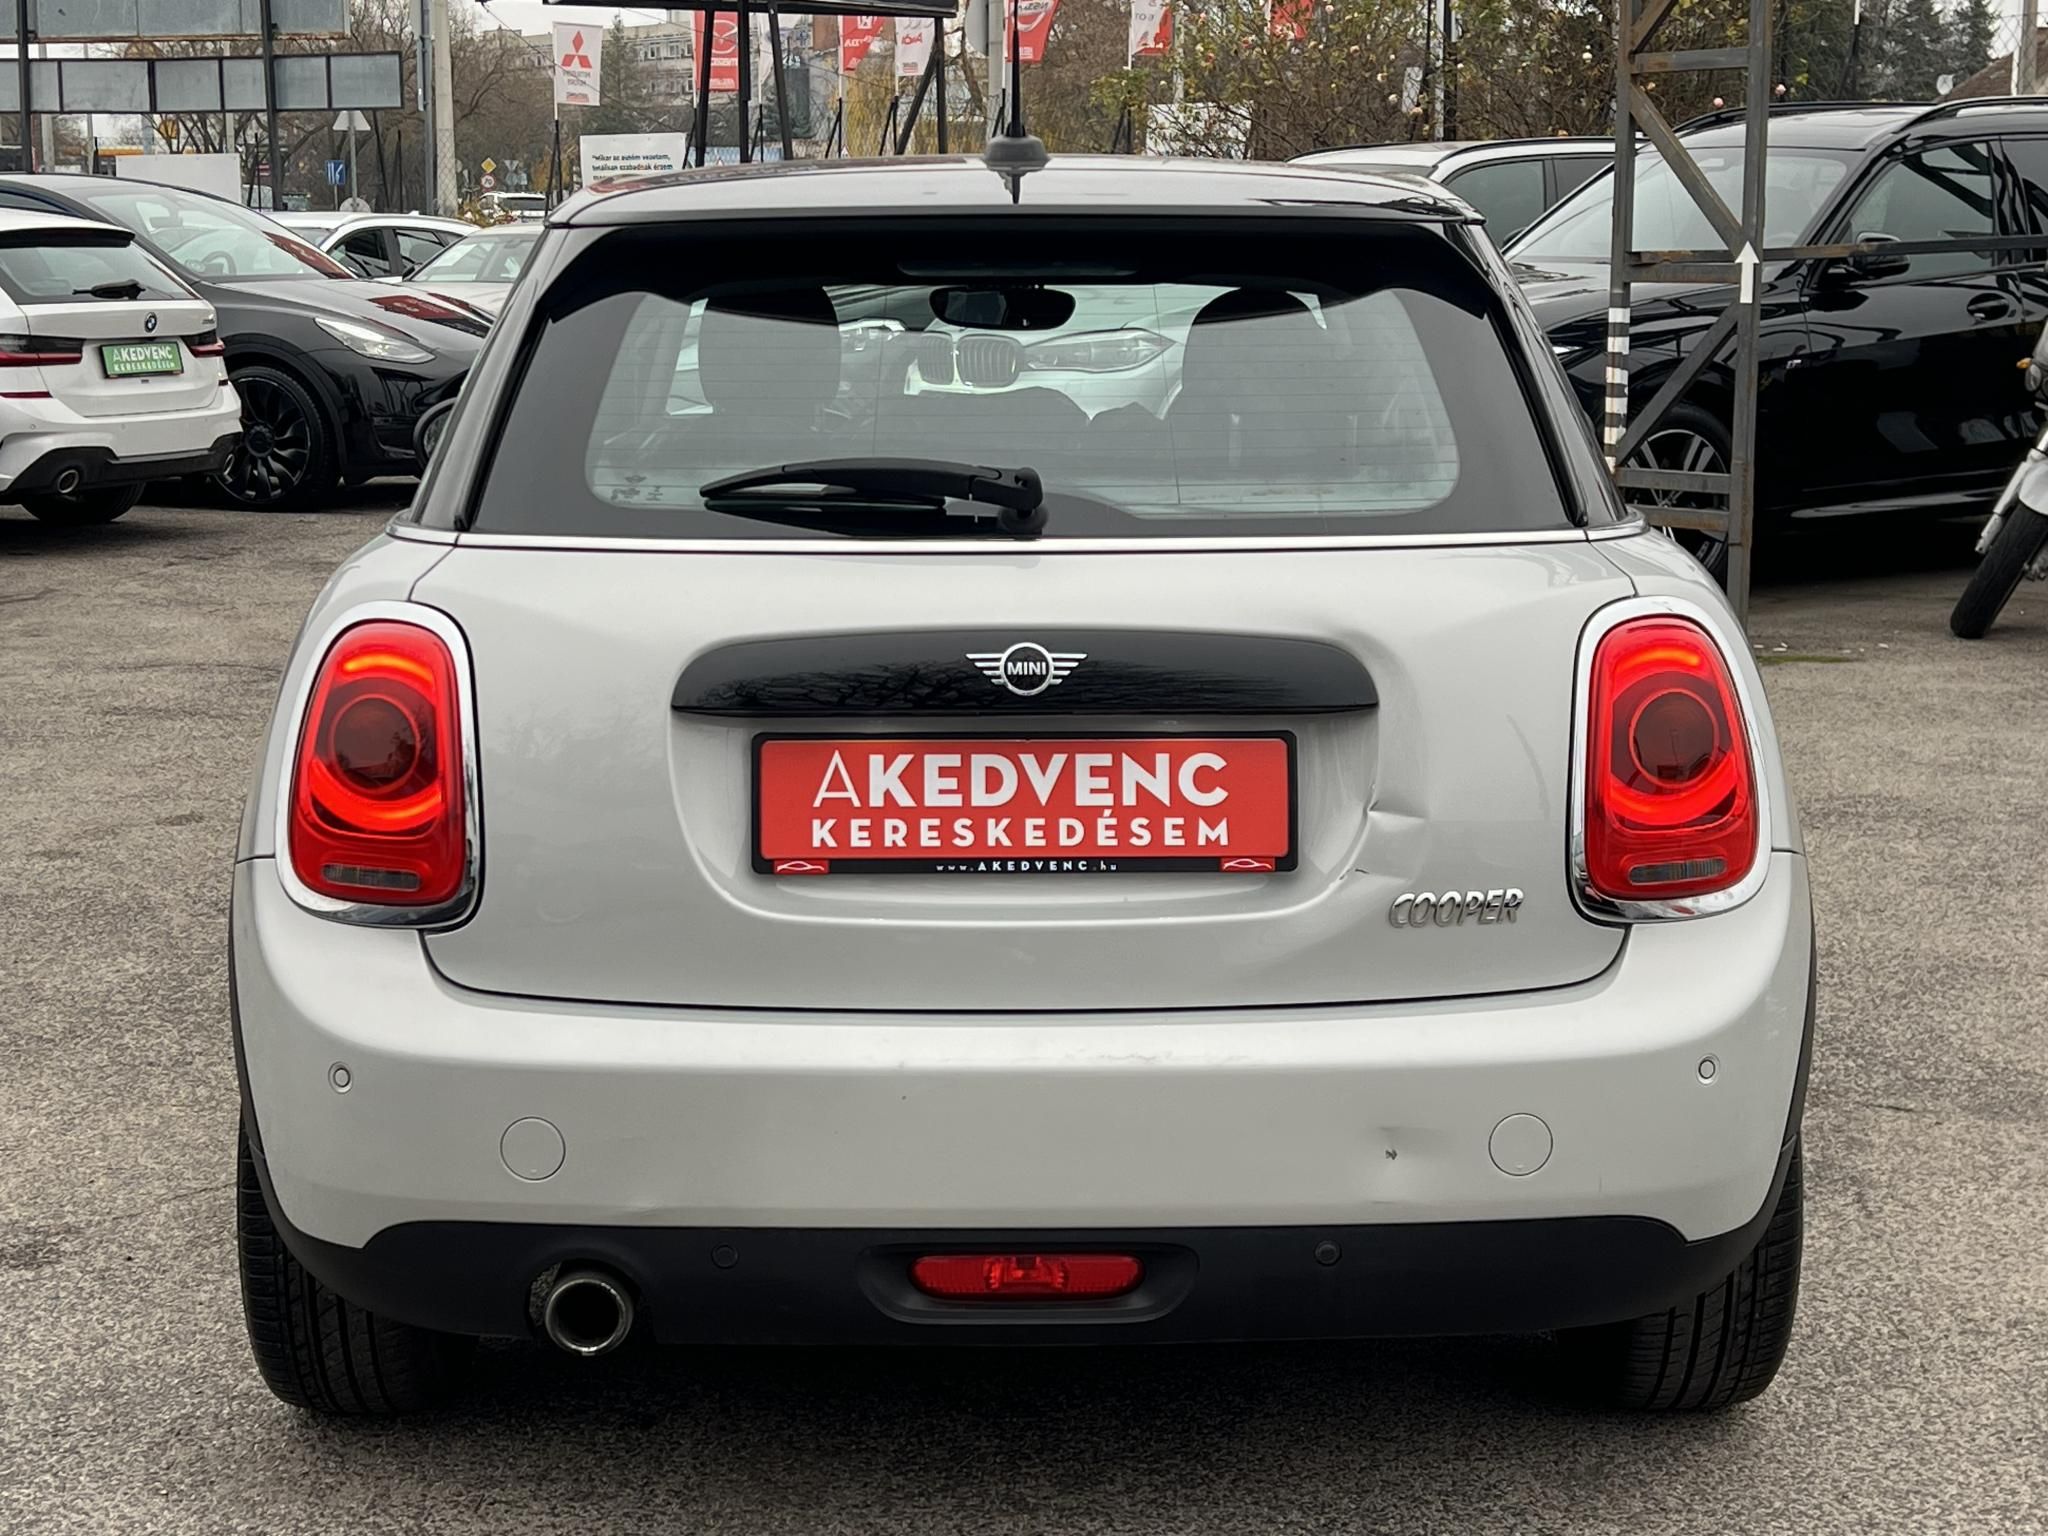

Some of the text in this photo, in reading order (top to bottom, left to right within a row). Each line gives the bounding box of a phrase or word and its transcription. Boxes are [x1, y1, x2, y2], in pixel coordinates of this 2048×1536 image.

[113, 346, 173, 362] AKEDVENC
[1007, 661, 1047, 676] MINI
[813, 750, 1229, 807] AKEDVENC
[812, 808, 1230, 848] KERESKEDÉSEM
[1389, 887, 1525, 928] COOPER
